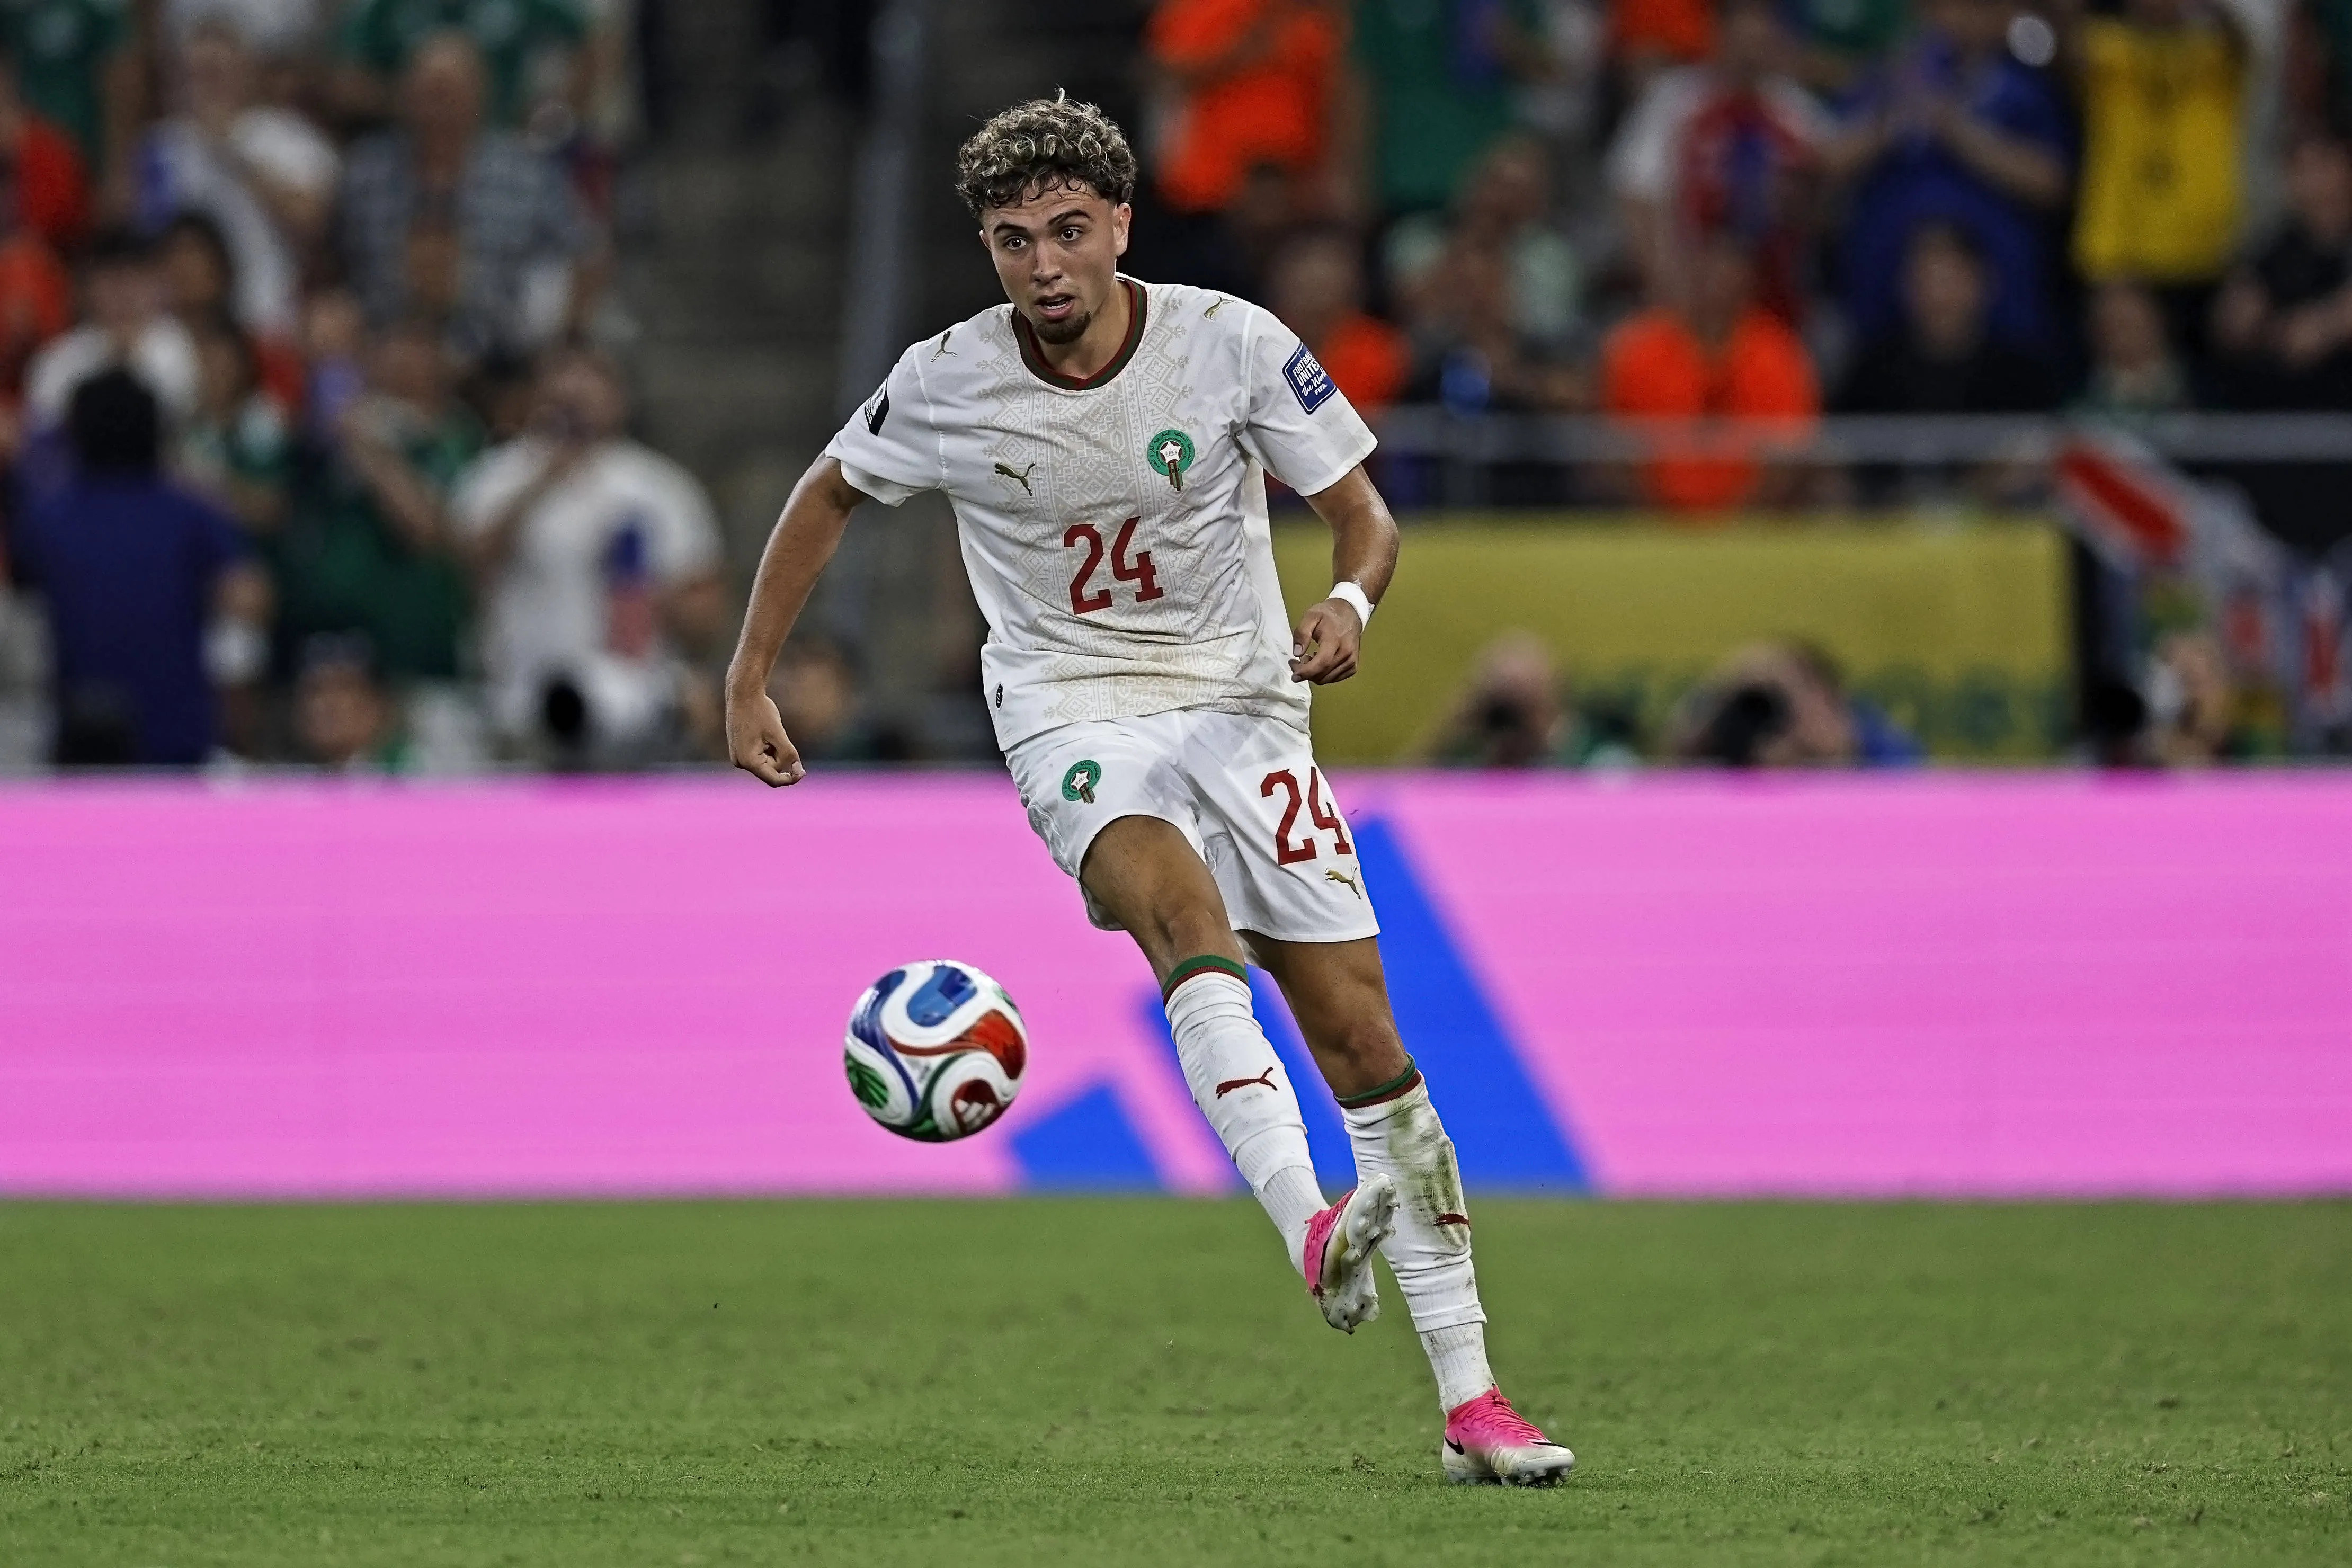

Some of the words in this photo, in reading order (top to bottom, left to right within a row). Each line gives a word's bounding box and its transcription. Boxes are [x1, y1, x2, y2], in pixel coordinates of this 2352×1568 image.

[1292, 350, 1313, 377] FOOTBALL
[1296, 358, 1320, 386] UNITES
[1302, 385, 1313, 397] the
[1314, 383, 1328, 395] FIFA
[1063, 516, 1164, 616] 24
[1260, 766, 1353, 866] 24
